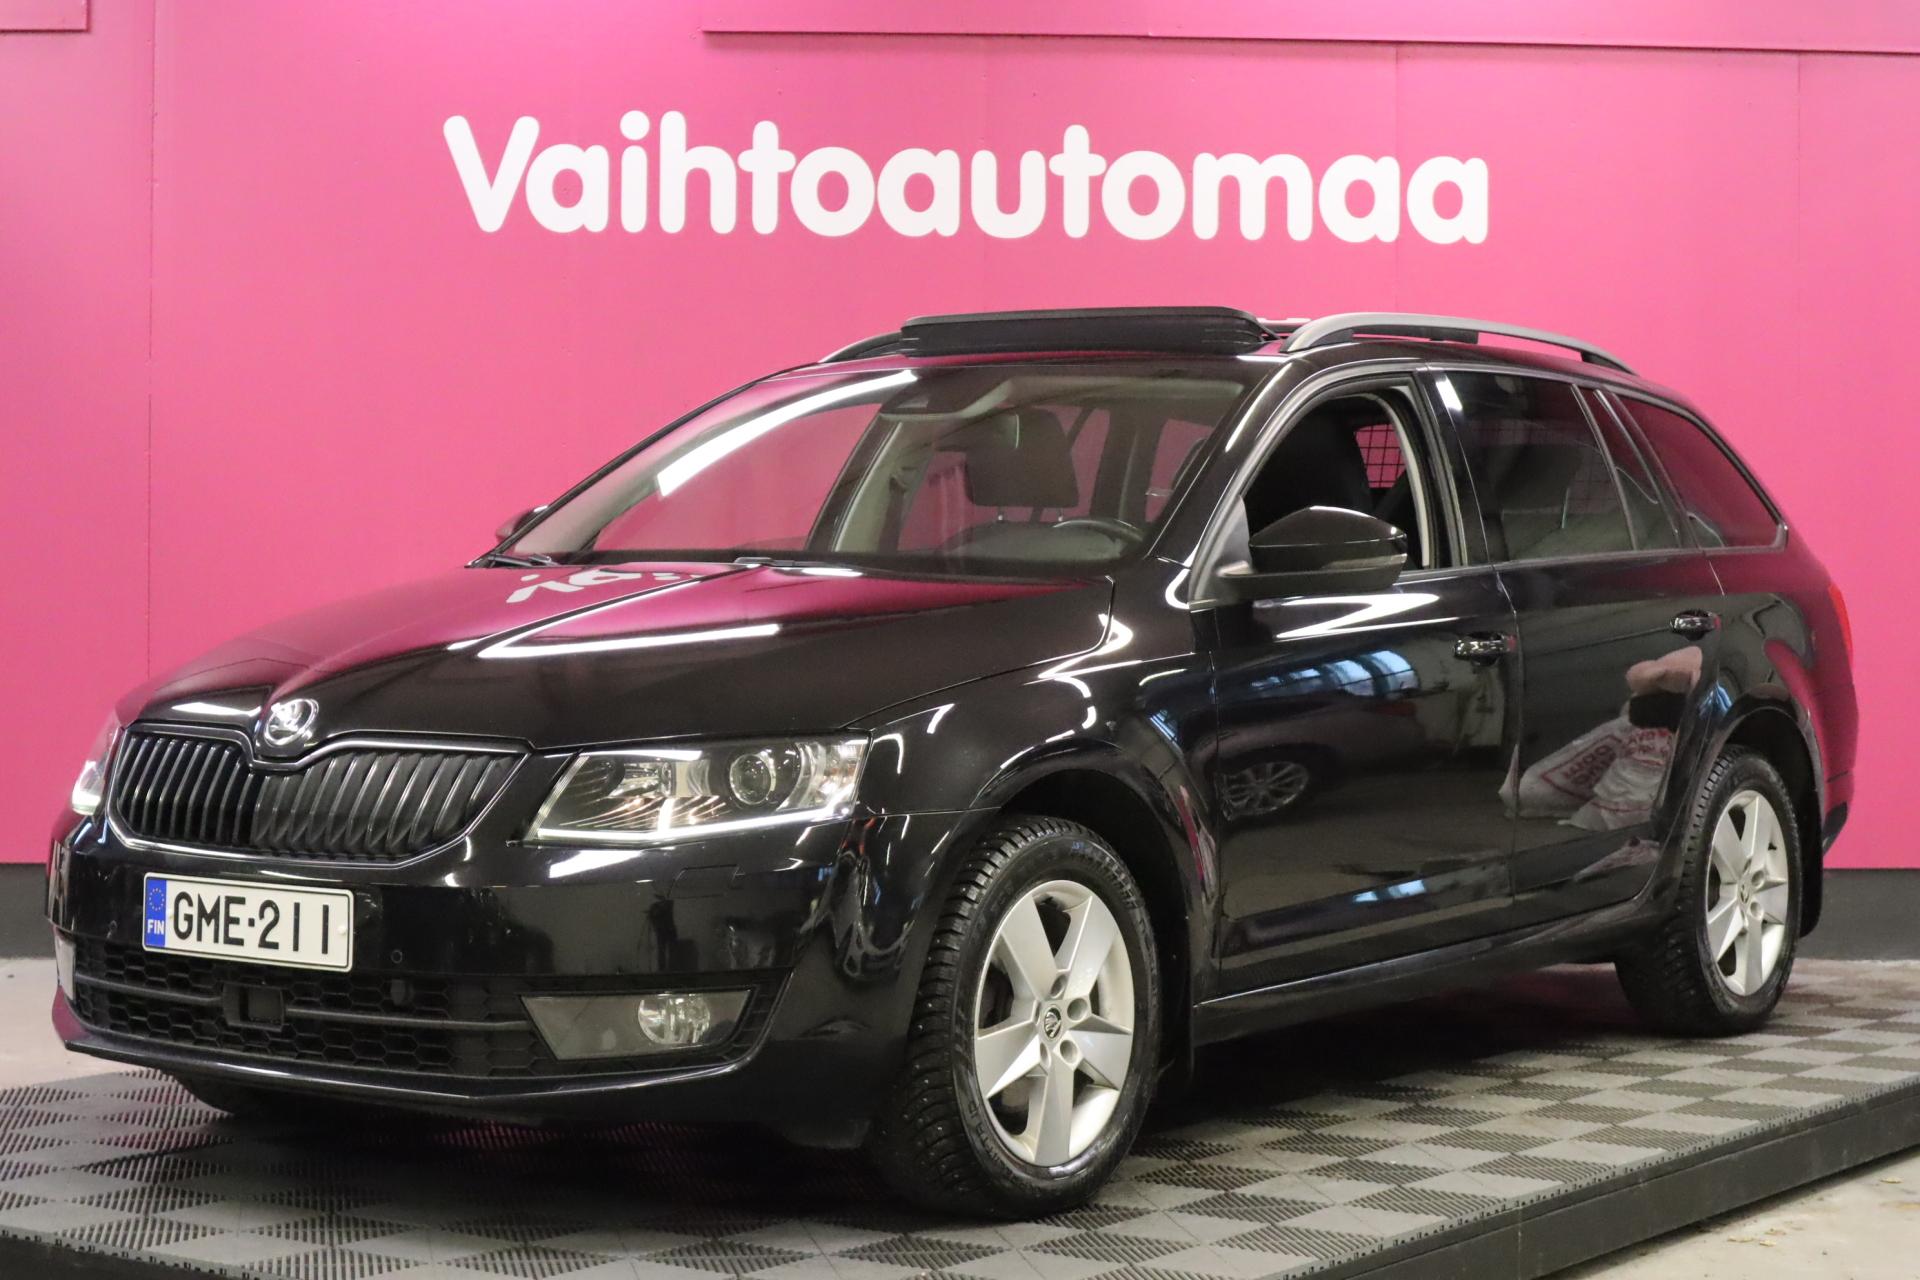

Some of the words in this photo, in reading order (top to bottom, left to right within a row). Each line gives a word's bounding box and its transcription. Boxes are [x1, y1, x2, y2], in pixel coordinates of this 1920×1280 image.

[443, 110, 1489, 245] Vaihtoautomaa
[147, 919, 165, 935] FIN
[173, 891, 329, 955] GME-211
